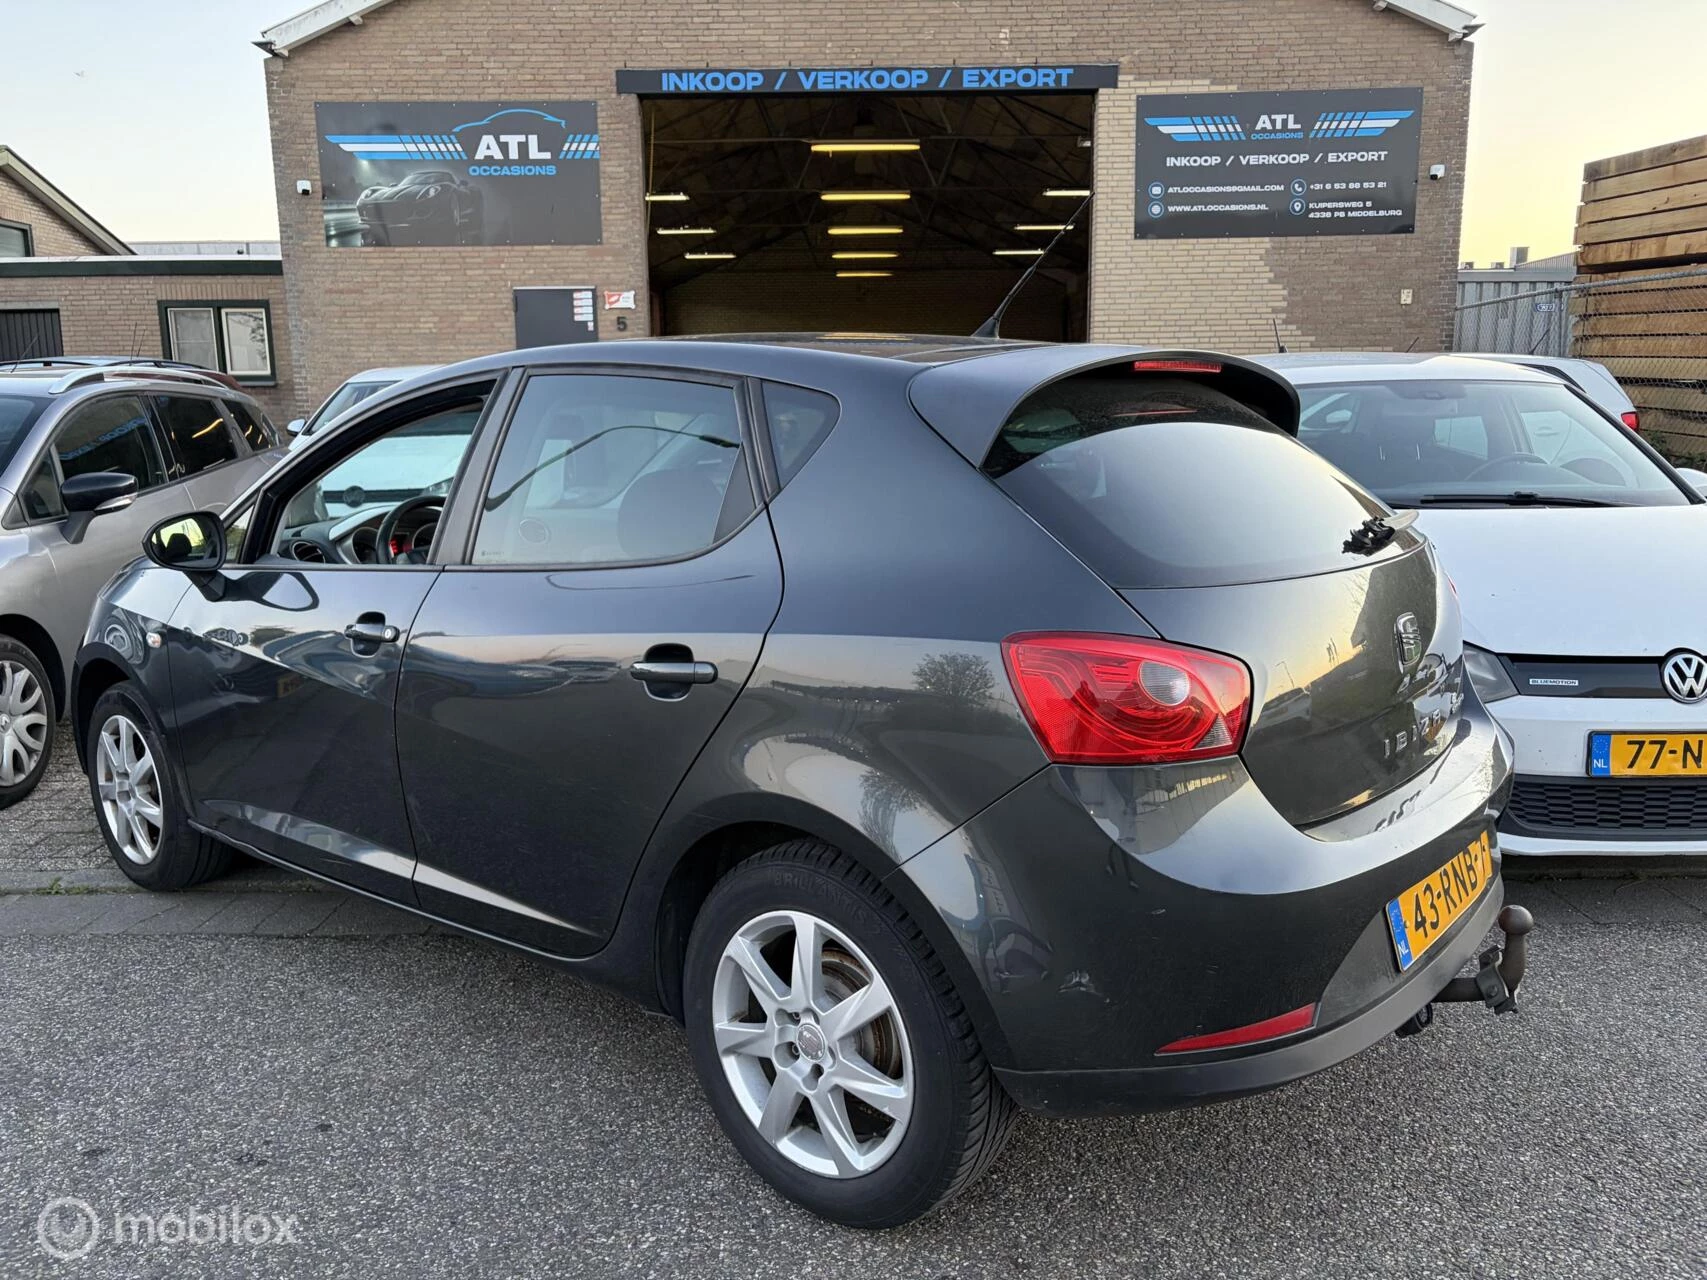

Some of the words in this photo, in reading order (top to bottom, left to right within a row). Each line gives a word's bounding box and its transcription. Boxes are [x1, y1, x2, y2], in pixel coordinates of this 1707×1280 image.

[662, 71, 764, 91] INKOOP
[774, 71, 787, 91] /
[797, 69, 929, 90] VERKOOP
[938, 69, 952, 88] /
[962, 68, 1074, 88] EXPORT
[1255, 114, 1301, 130] ATL
[1250, 132, 1304, 140] OCCASIONS
[474, 134, 551, 160] ATL
[1166, 156, 1221, 167] INKOOP
[1226, 155, 1234, 167] /
[1239, 153, 1310, 166] VERKOOP
[1314, 152, 1323, 164] /
[1327, 151, 1388, 163] EXPORT
[469, 165, 556, 176] OCCASIONS
[1167, 204, 1269, 212] WWW.ATLOCCASIONS.NL
[616, 316, 628, 331] 5
[1384, 709, 1442, 759] IBIZA
[1593, 759, 1608, 769] NL
